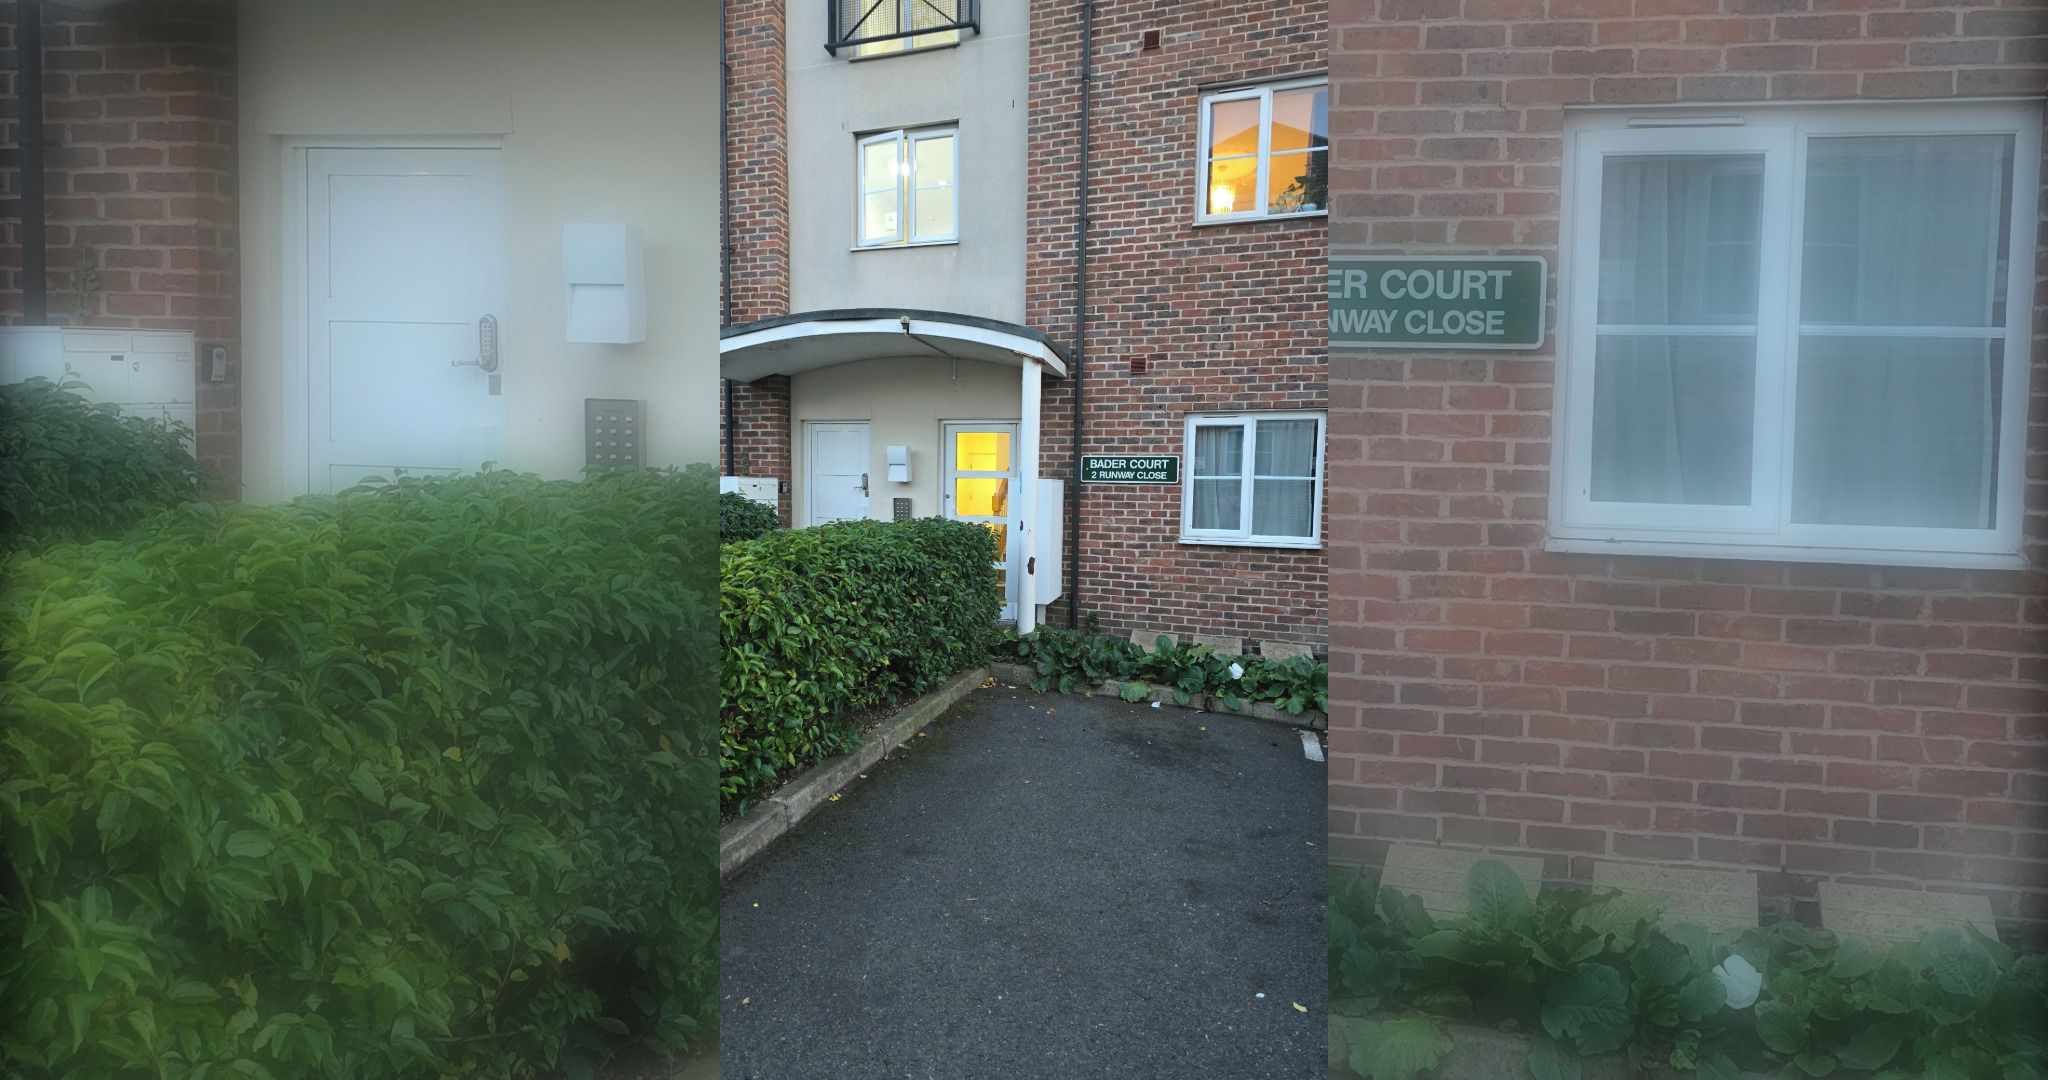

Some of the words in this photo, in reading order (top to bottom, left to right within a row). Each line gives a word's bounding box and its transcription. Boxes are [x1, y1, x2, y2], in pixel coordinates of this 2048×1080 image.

[1380, 269, 1512, 300] COURT
[1404, 309, 1505, 335] CLOSE
[1090, 459, 1126, 469] BADER
[1129, 459, 1169, 469] COURT
[1091, 471, 1097, 479] 2
[1099, 471, 1135, 479] RUNWAY
[1136, 471, 1167, 480] CLOSE
